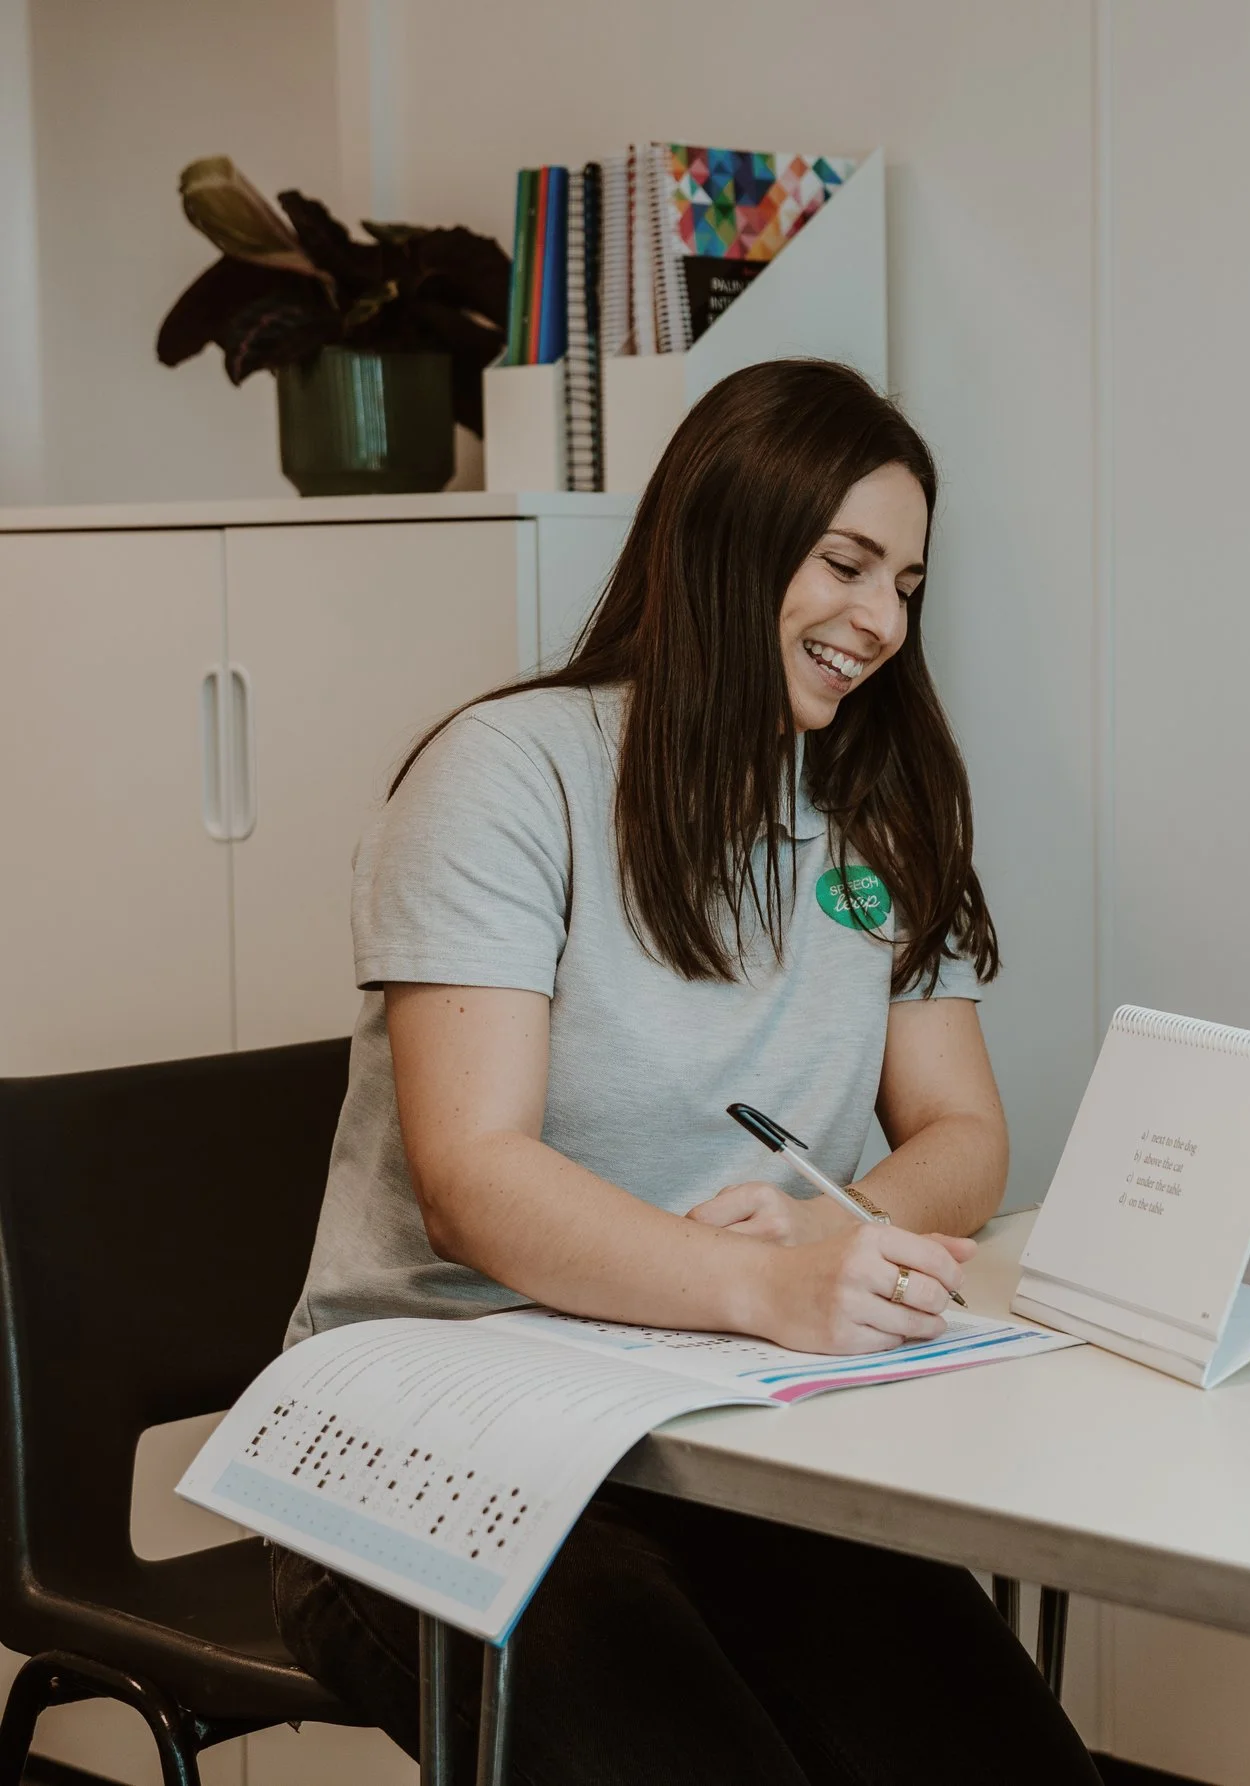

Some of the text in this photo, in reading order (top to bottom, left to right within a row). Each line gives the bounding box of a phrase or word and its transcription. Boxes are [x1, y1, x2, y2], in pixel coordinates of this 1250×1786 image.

[1141, 1130, 1198, 1157] a) next to the dog
[1133, 1149, 1184, 1173] b) above the cat
[1126, 1171, 1182, 1197] c) under the table
[1118, 1191, 1165, 1216] d) on the table
